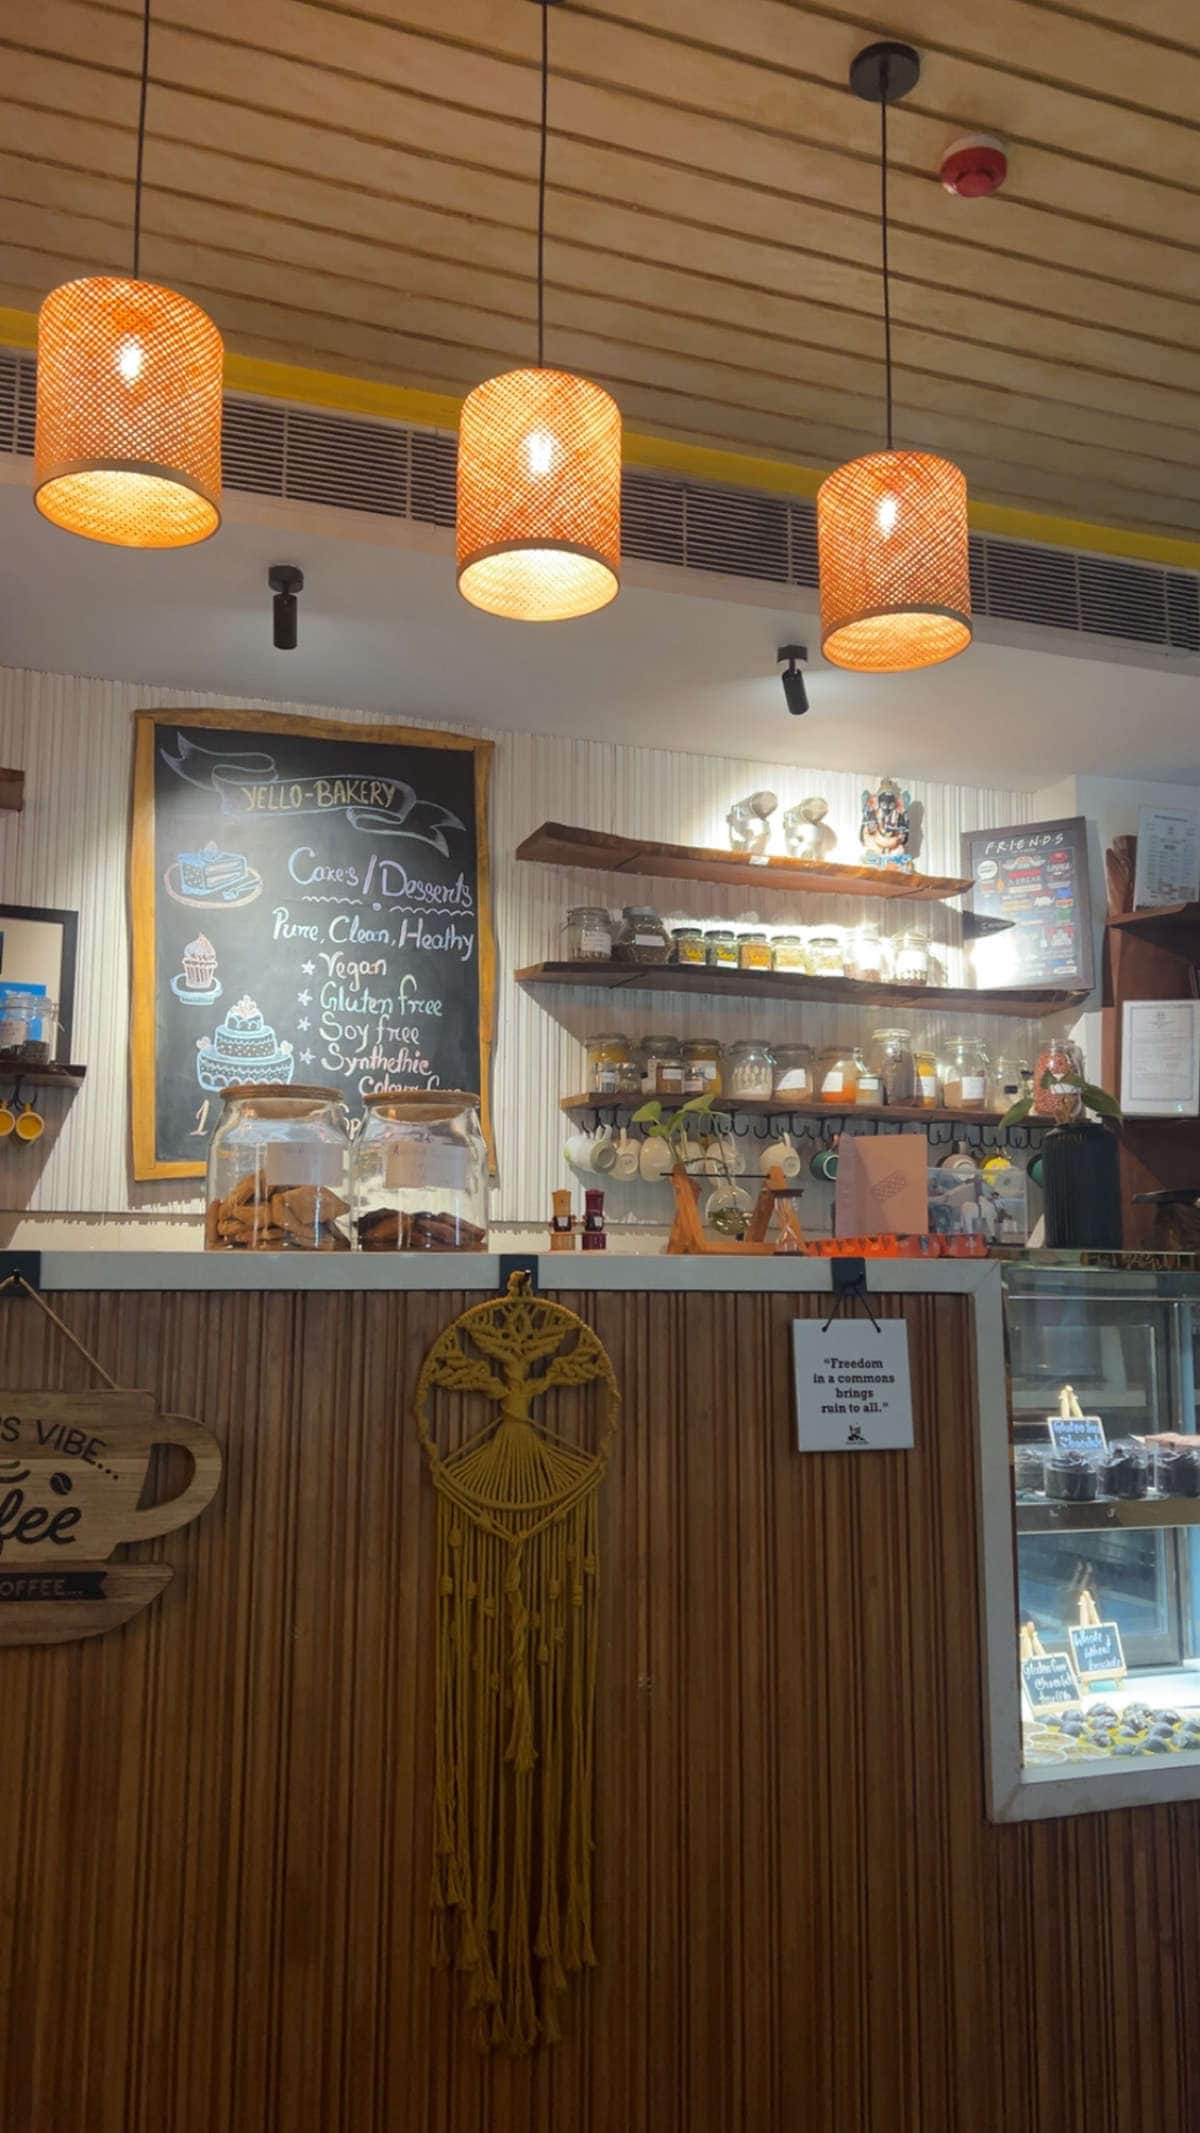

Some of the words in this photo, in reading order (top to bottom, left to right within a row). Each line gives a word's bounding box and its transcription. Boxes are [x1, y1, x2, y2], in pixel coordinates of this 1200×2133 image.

[239, 779, 397, 811] YELLO-BAKERY
[318, 951, 387, 992] Vegan
[320, 980, 394, 1015] Gluten
[398, 973, 443, 1016] free
[319, 1010, 369, 1053] Soy
[375, 1014, 420, 1045] free
[813, 1373, 825, 1383] in
[828, 1375, 835, 1384] a
[837, 1374, 896, 1384] commons
[835, 1387, 874, 1401] brings
[821, 1402, 847, 1413] ruin
[849, 1403, 860, 1413] to
